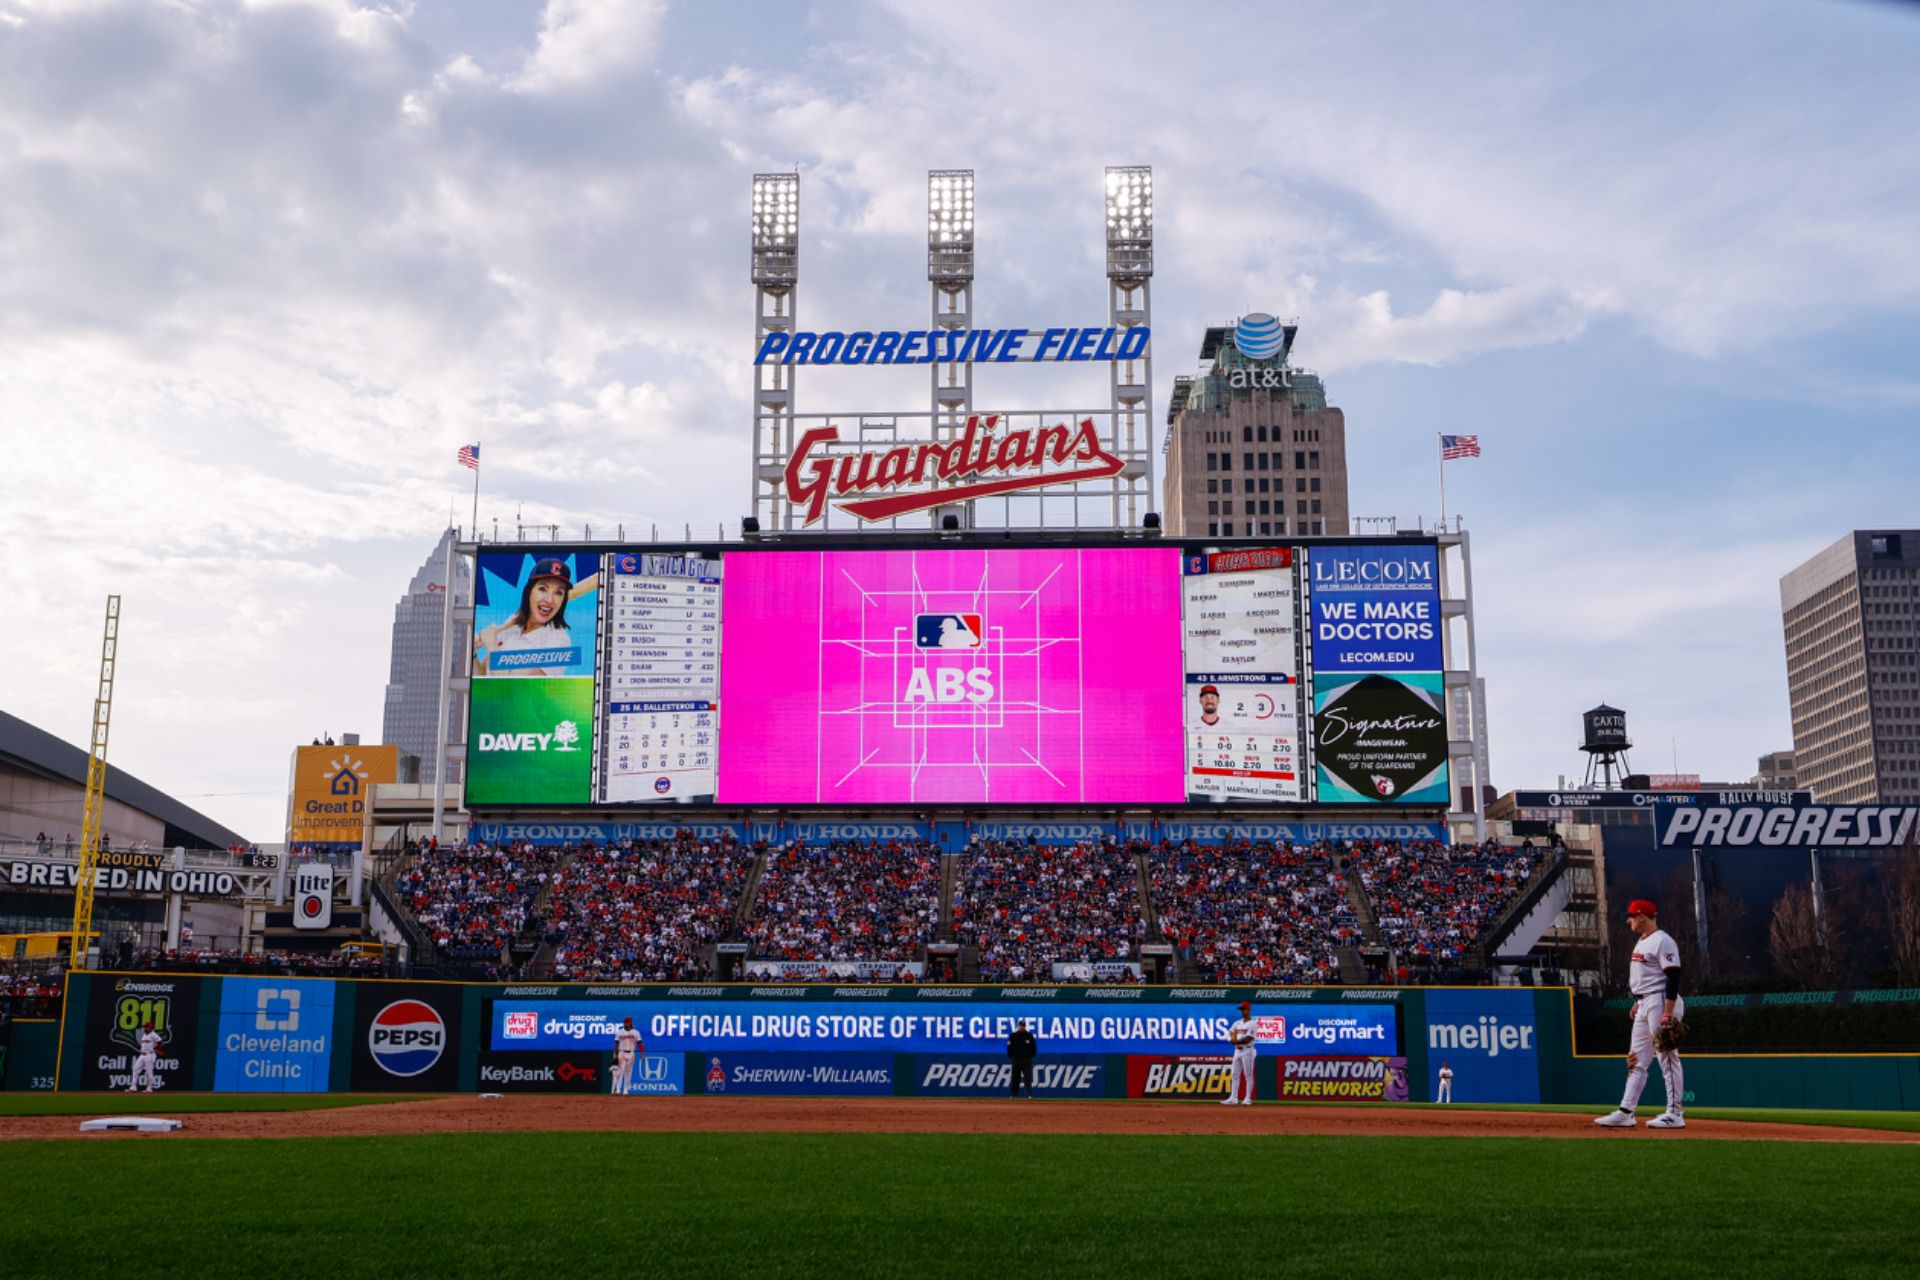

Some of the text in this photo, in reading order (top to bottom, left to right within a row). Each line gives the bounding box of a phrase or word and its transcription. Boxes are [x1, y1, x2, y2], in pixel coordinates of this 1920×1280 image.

[754, 327, 1151, 366] PROGRESSIVE FIELD
[1229, 363, 1292, 389] at&t
[784, 413, 1125, 528] Guardians
[1320, 602, 1429, 619] WE MAKE
[1320, 622, 1434, 640] DOCTORS
[498, 651, 575, 666] PROGRESSIVE
[1340, 652, 1415, 662] LECOM.EDU
[904, 667, 994, 702] ABS
[644, 703, 695, 711] BALLESTEROS
[1237, 702, 1244, 711] 2
[1258, 703, 1265, 711] 3
[1320, 707, 1441, 745] Signature
[1593, 716, 1625, 727] CAXTO
[479, 733, 552, 751] DAVEY
[1719, 792, 1794, 805] RALLY HOUSE
[306, 800, 348, 813] Great
[298, 816, 364, 828] Improvem
[1663, 808, 1920, 846] PROGRESSI
[505, 825, 606, 839] HONDA
[818, 825, 920, 839] HONDA
[1005, 825, 1104, 839] HONDA
[1190, 825, 1297, 839] HONDA
[1329, 825, 1436, 839] HONDA
[136, 870, 163, 891] IN
[170, 871, 233, 895] OHIO
[299, 875, 330, 894] Lite
[124, 983, 175, 992] ENBRIDGE
[504, 987, 559, 995] PROGRESSIVE
[586, 987, 641, 995] PROGRESSIVE
[668, 987, 723, 996] PROGRESSIVE
[750, 988, 806, 996] PROGRESSIVE
[833, 988, 889, 996] PROGRESSIVE
[917, 988, 973, 997] PROGRESSIVE
[1001, 988, 1057, 997] PROGRESSIVE
[1085, 989, 1142, 998] PROGRESSIVE
[1169, 989, 1227, 998] PROGRESSIVE
[1255, 989, 1313, 999] PROGRESSIVE
[1341, 990, 1400, 999] PROGRESSIVE
[1762, 991, 1837, 1004] PROGRESSIVE
[1852, 988, 1920, 1003] PROGRESSI
[119, 998, 166, 1030] 811
[544, 1019, 624, 1038] drug mar
[652, 1014, 1230, 1040] OFFICIAL DRUG STORE OF THE CLEVELAND GUARDIANS
[1292, 1023, 1385, 1043] drug mart
[226, 1033, 325, 1052] Cleveland
[374, 1029, 441, 1046] PEPSI
[1430, 1016, 1533, 1056] meijer
[98, 1056, 126, 1069] Call
[245, 1060, 302, 1078] Clinic
[1285, 1061, 1384, 1078] PHANTOM
[139, 1074, 165, 1088] dg.
[480, 1066, 554, 1083] KeyBank
[732, 1066, 888, 1082] SHERWIN-WILLIAMS
[922, 1064, 1098, 1089] PROGRSSIVE
[31, 1077, 54, 1089] 325
[1283, 1081, 1384, 1096] FIREWORKS
